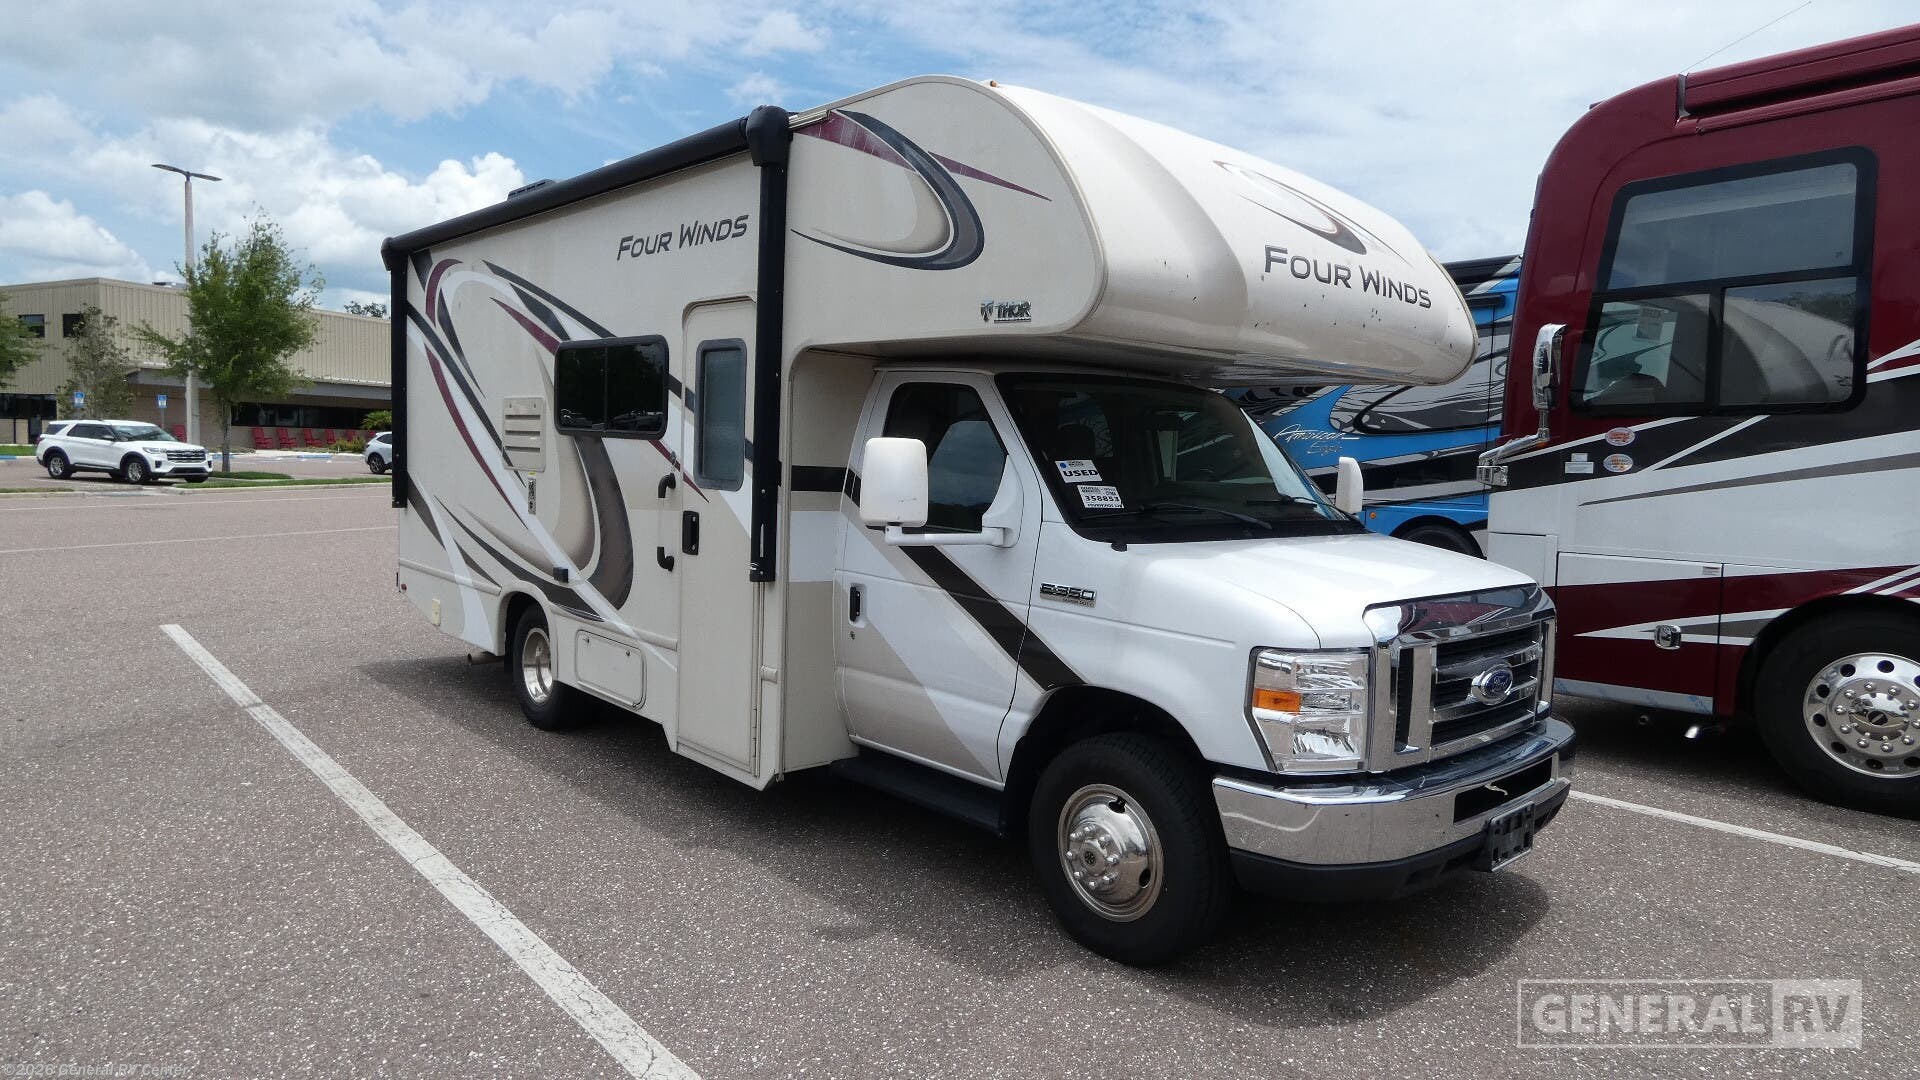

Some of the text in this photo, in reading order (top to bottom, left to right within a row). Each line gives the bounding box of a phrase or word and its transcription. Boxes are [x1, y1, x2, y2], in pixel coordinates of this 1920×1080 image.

[617, 215, 749, 261] FOUR WINDS
[1264, 245, 1432, 309] FOUR WINDS
[994, 302, 1031, 319] THOR
[1063, 469, 1098, 477] USED
